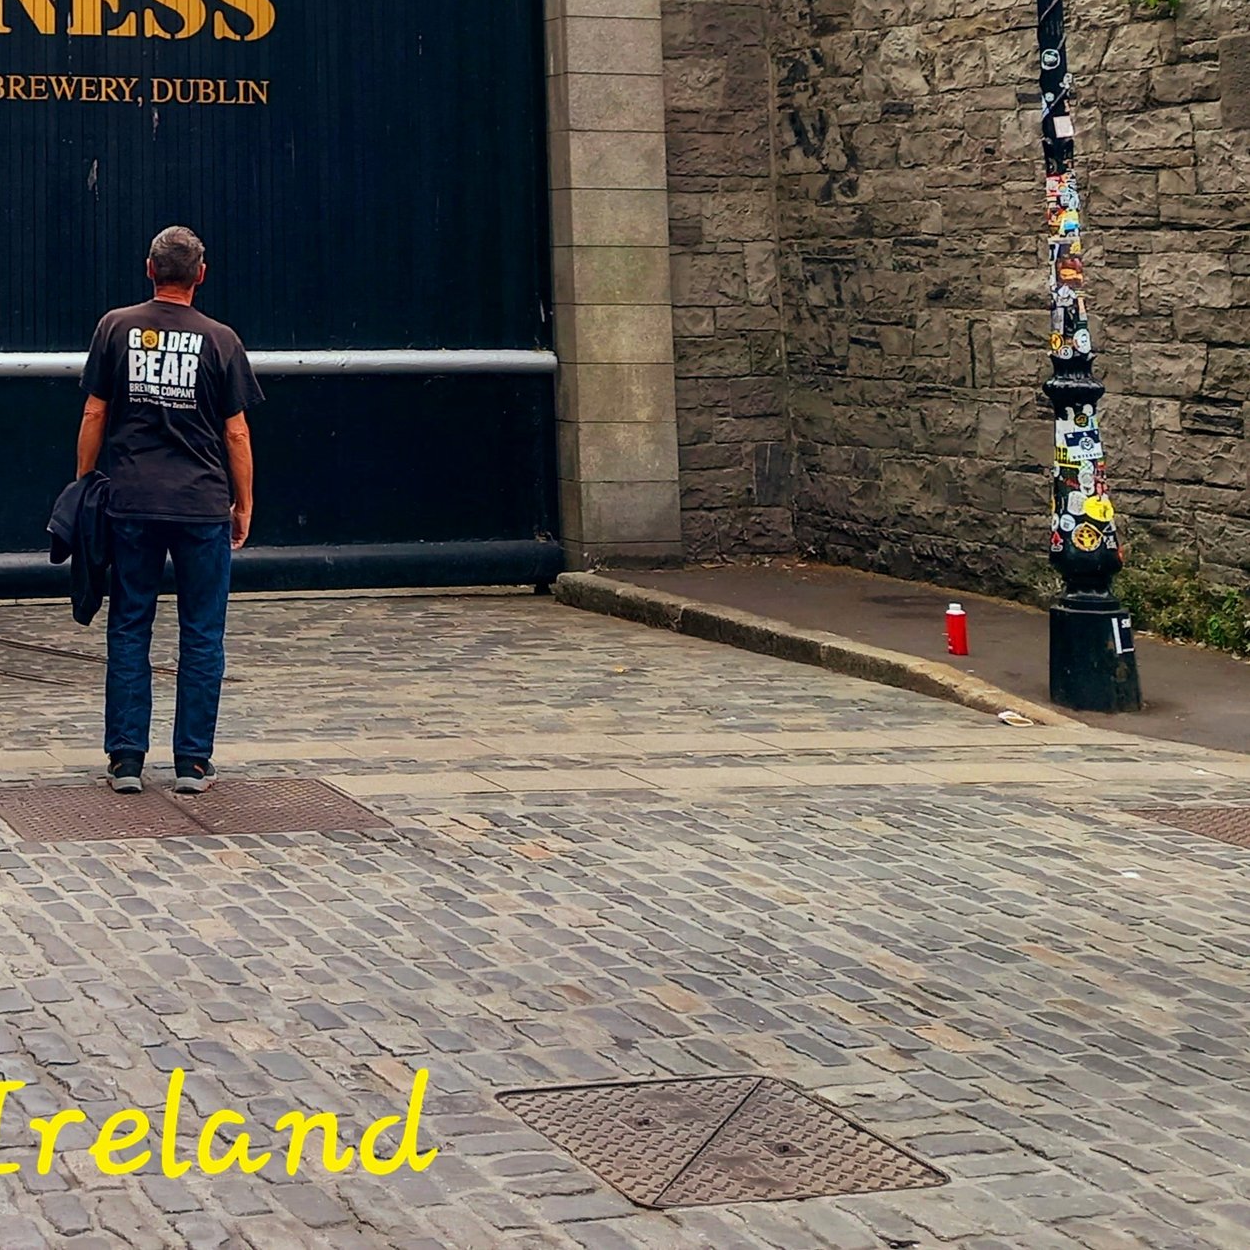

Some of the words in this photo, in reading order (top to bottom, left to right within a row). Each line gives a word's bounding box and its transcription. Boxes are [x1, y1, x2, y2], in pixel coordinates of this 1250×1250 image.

[150, 78, 269, 104] DUBLIN
[128, 328, 203, 354] GOLDEN
[128, 350, 199, 387] BEAR
[160, 385, 196, 399] COMPANY
